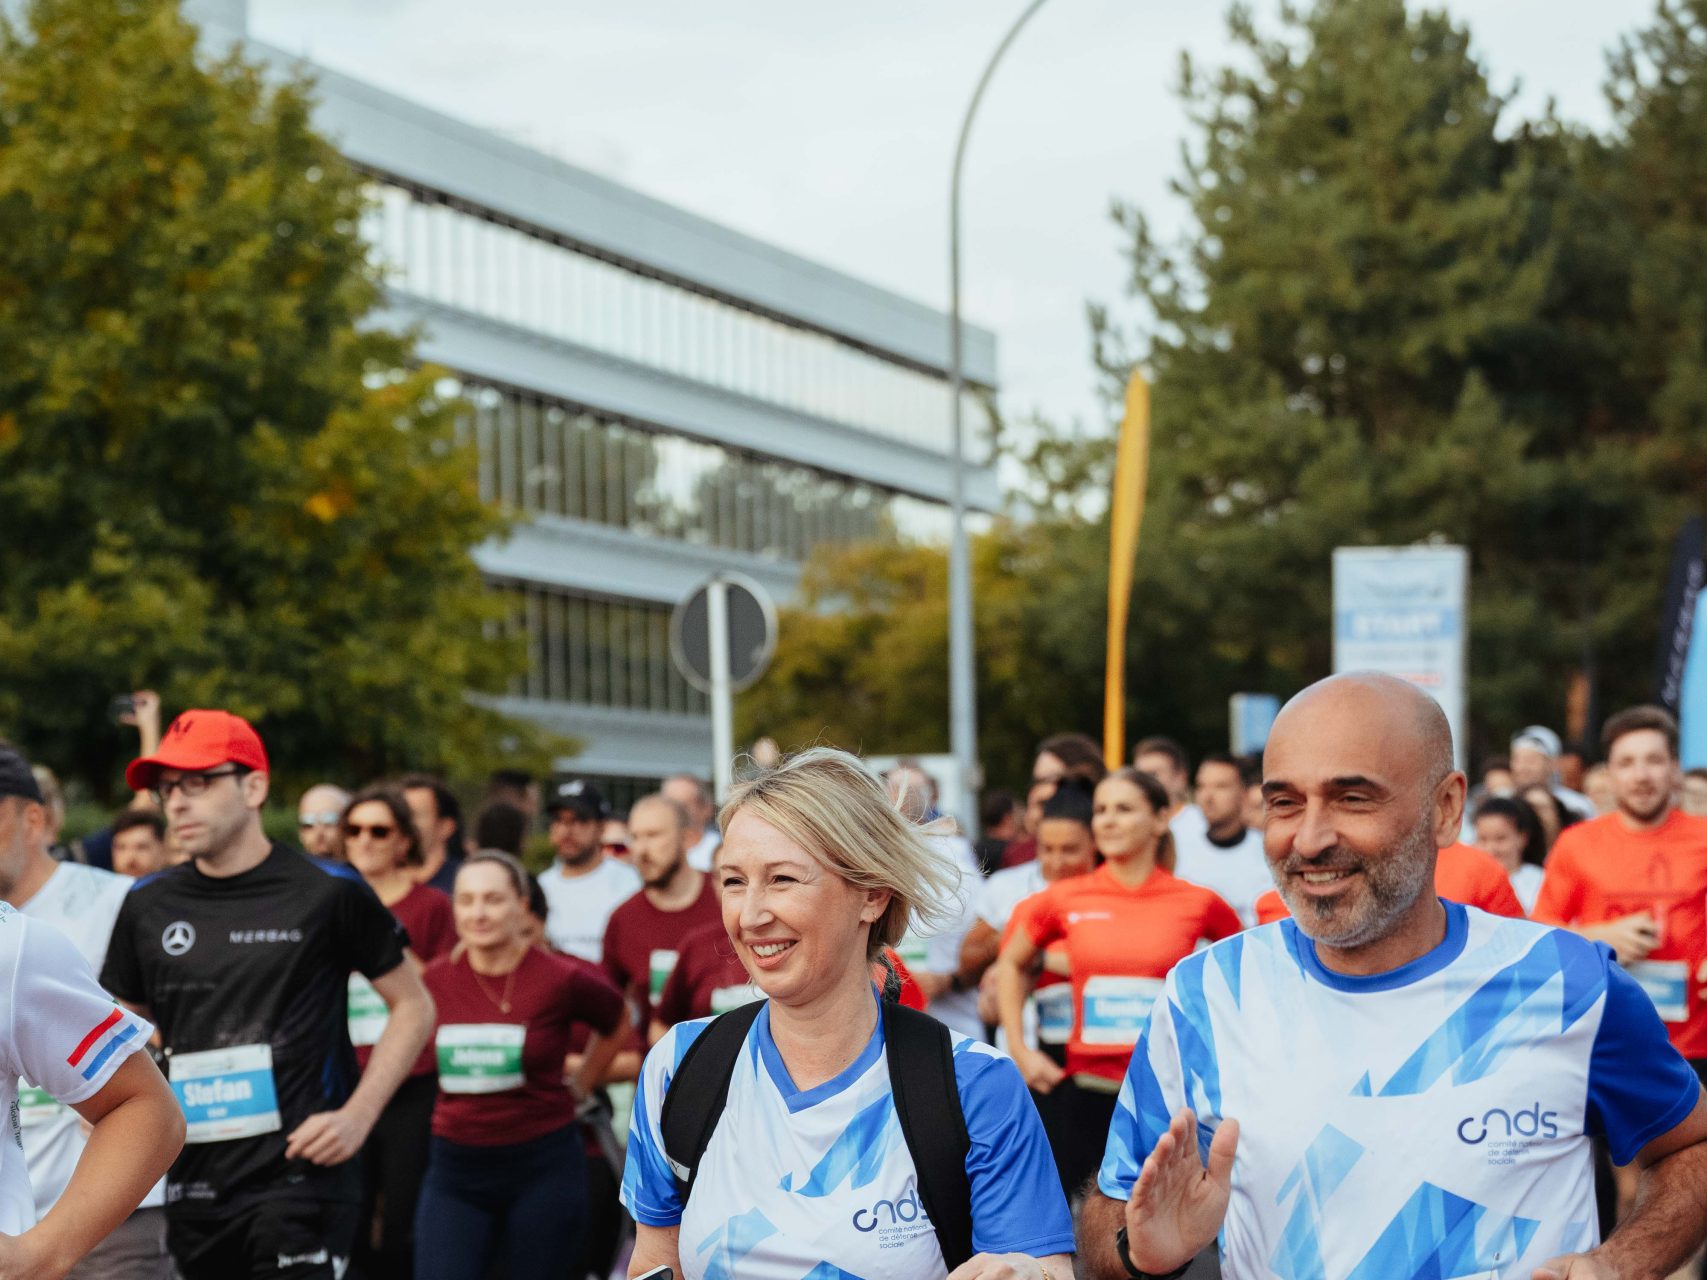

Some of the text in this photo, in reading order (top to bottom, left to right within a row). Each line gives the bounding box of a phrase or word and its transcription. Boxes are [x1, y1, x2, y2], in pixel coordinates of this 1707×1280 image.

[229, 929, 303, 944] MERBAG
[183, 1078, 252, 1108] Stefan
[1457, 1101, 1558, 1145] cnds
[878, 1225, 903, 1235] comité
[878, 1234, 889, 1242] de
[879, 1240, 906, 1250] sociale
